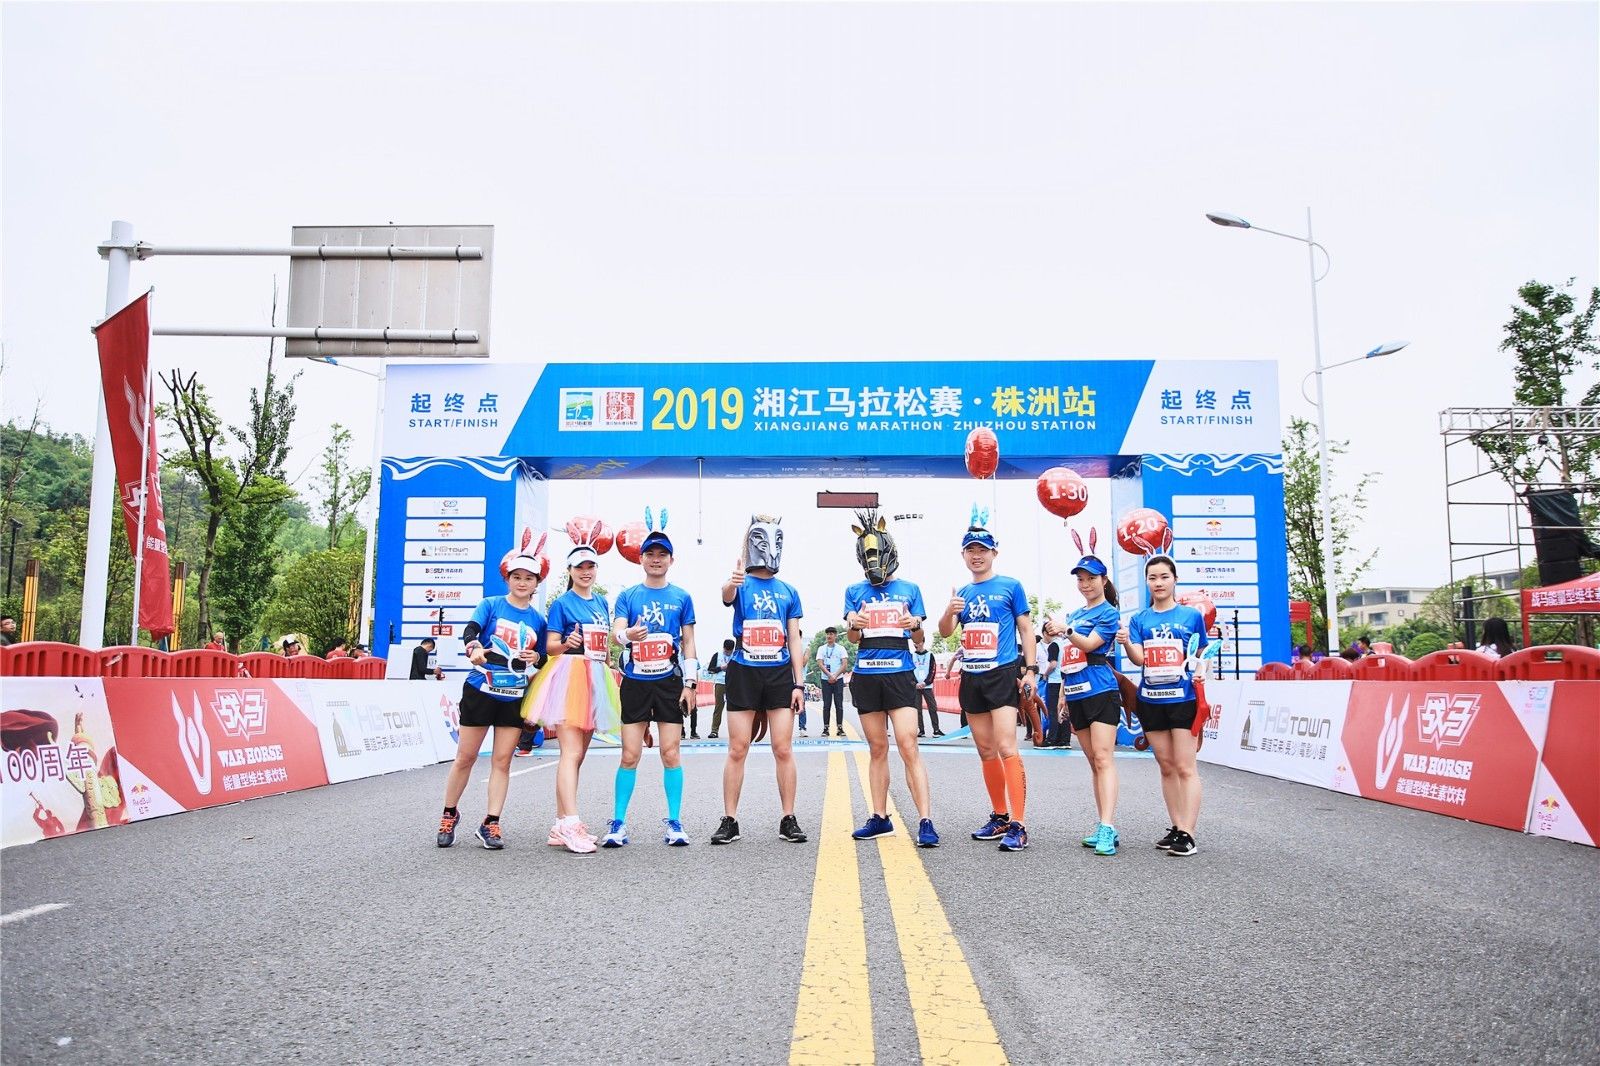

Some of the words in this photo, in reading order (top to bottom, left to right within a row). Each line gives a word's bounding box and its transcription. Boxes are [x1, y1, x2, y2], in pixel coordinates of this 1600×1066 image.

[410, 392, 498, 413] 起终点
[651, 387, 744, 430] 2019
[1160, 389, 1252, 410] 起终点
[408, 418, 498, 428] START/FINISH
[753, 420, 849, 431] XIANGJIANG
[857, 420, 942, 431] MARATHON
[953, 420, 1026, 431] ZHUZHOU
[1031, 420, 1096, 431] STATION
[1160, 415, 1253, 425] START/FINISH
[1049, 481, 1088, 502] 1:30
[1120, 517, 1160, 543] 1:20
[753, 589, 777, 614] 战
[874, 611, 899, 624] 1:20
[755, 629, 779, 643] 1:10
[969, 632, 992, 646] 1:00
[643, 642, 668, 658] 1:30
[1152, 649, 1178, 663] 1:20
[0, 743, 93, 783] 00周年
[217, 748, 246, 767] WAR
[244, 744, 284, 765] HORSE
[1402, 753, 1427, 773] WAR
[1426, 756, 1473, 780] HORSE
[223, 767, 288, 791] 能量型维生素饮料
[1395, 777, 1467, 806] 能量型维生素饮料
